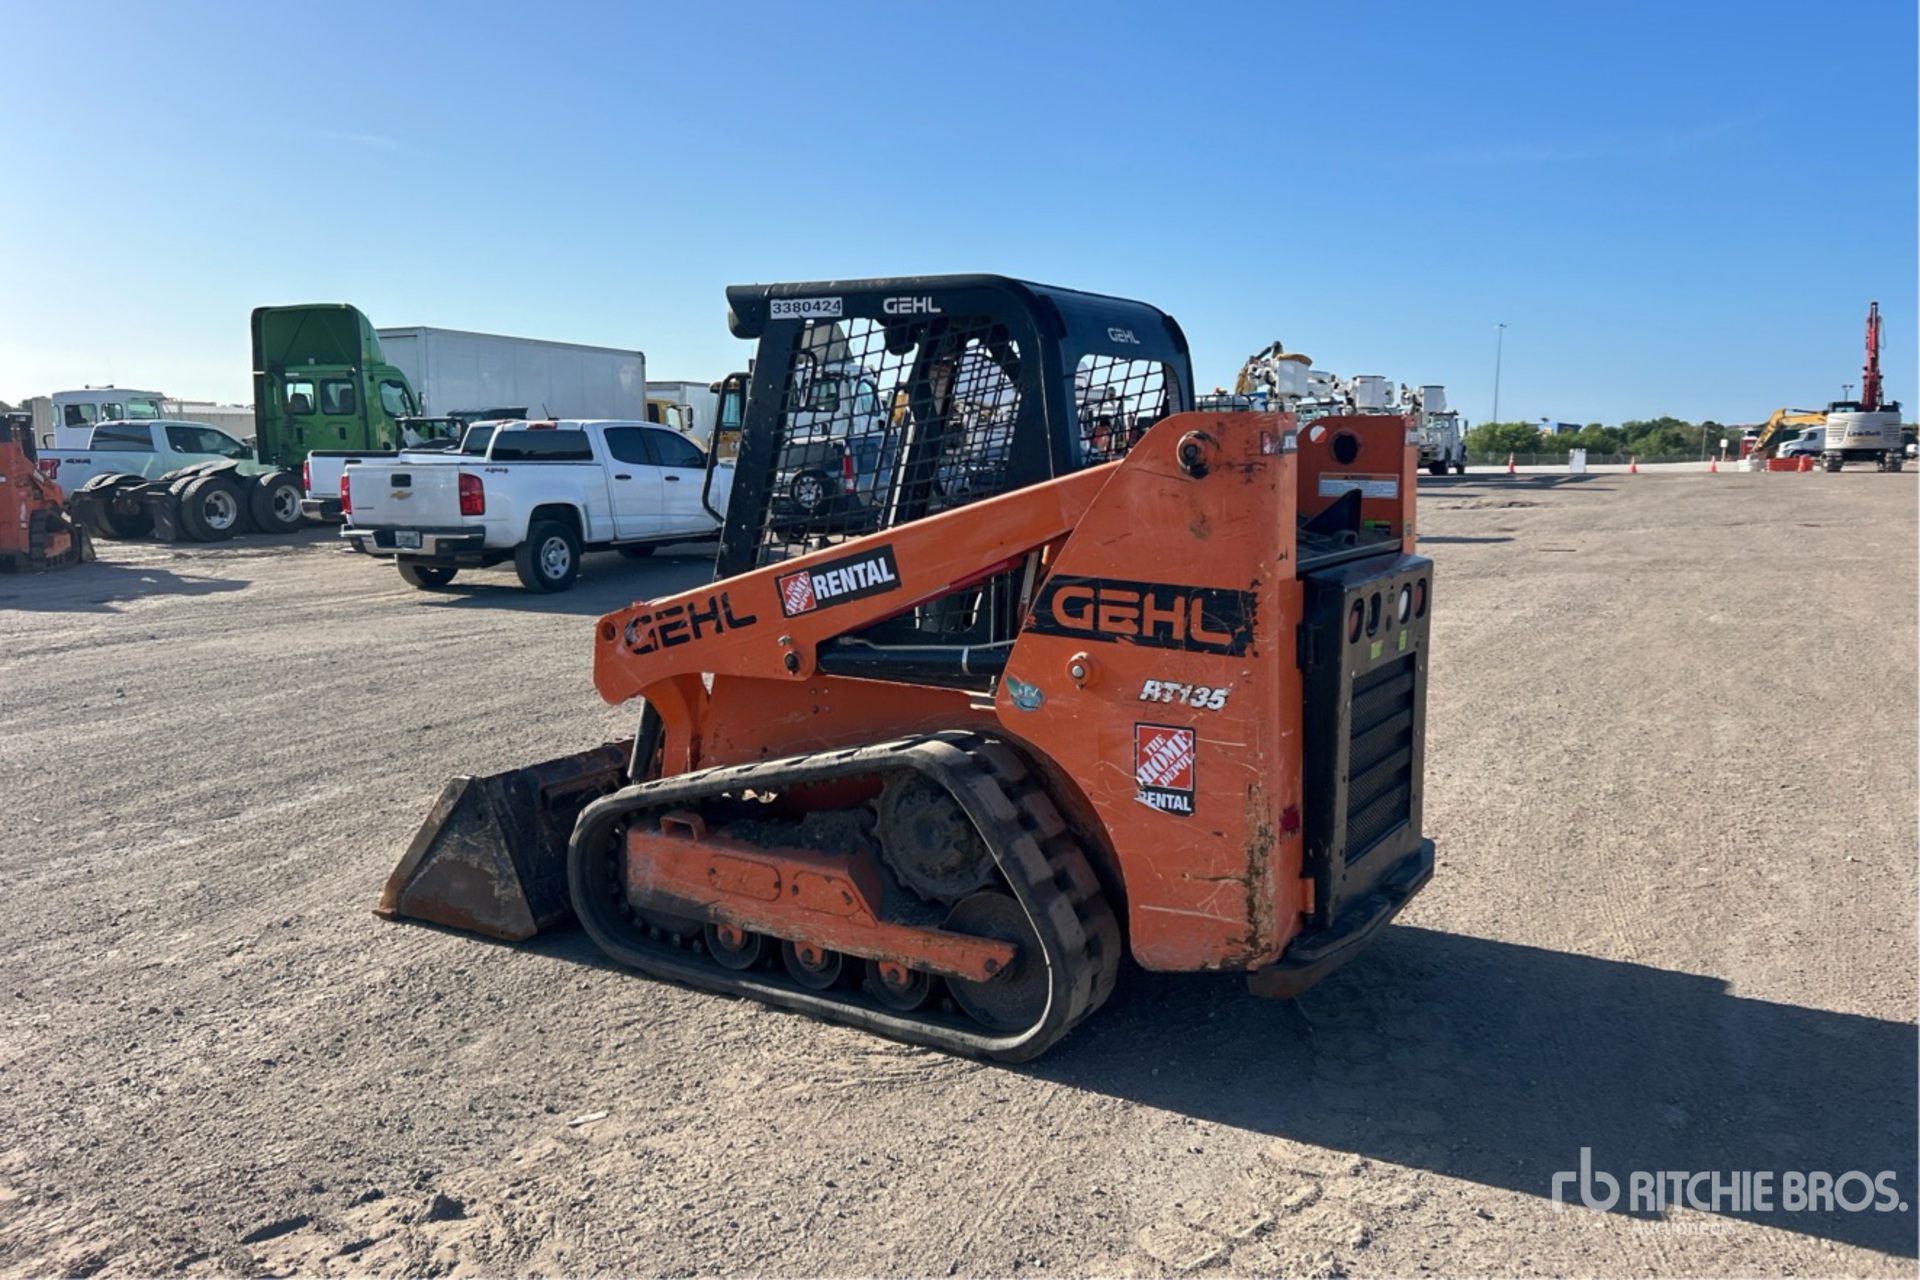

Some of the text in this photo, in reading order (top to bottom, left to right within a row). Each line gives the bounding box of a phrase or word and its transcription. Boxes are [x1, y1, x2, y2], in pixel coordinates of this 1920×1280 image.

[773, 300, 841, 314] 3380424
[883, 296, 941, 314] GEHL
[1107, 327, 1140, 344] GEHL
[812, 556, 895, 600] RENTAL
[624, 591, 757, 656] GEHL
[1052, 585, 1232, 645] GEHL
[1138, 678, 1230, 711] RT135
[1136, 730, 1192, 785] HOME
[1143, 733, 1167, 756] THE
[1158, 752, 1194, 787] DEPOT
